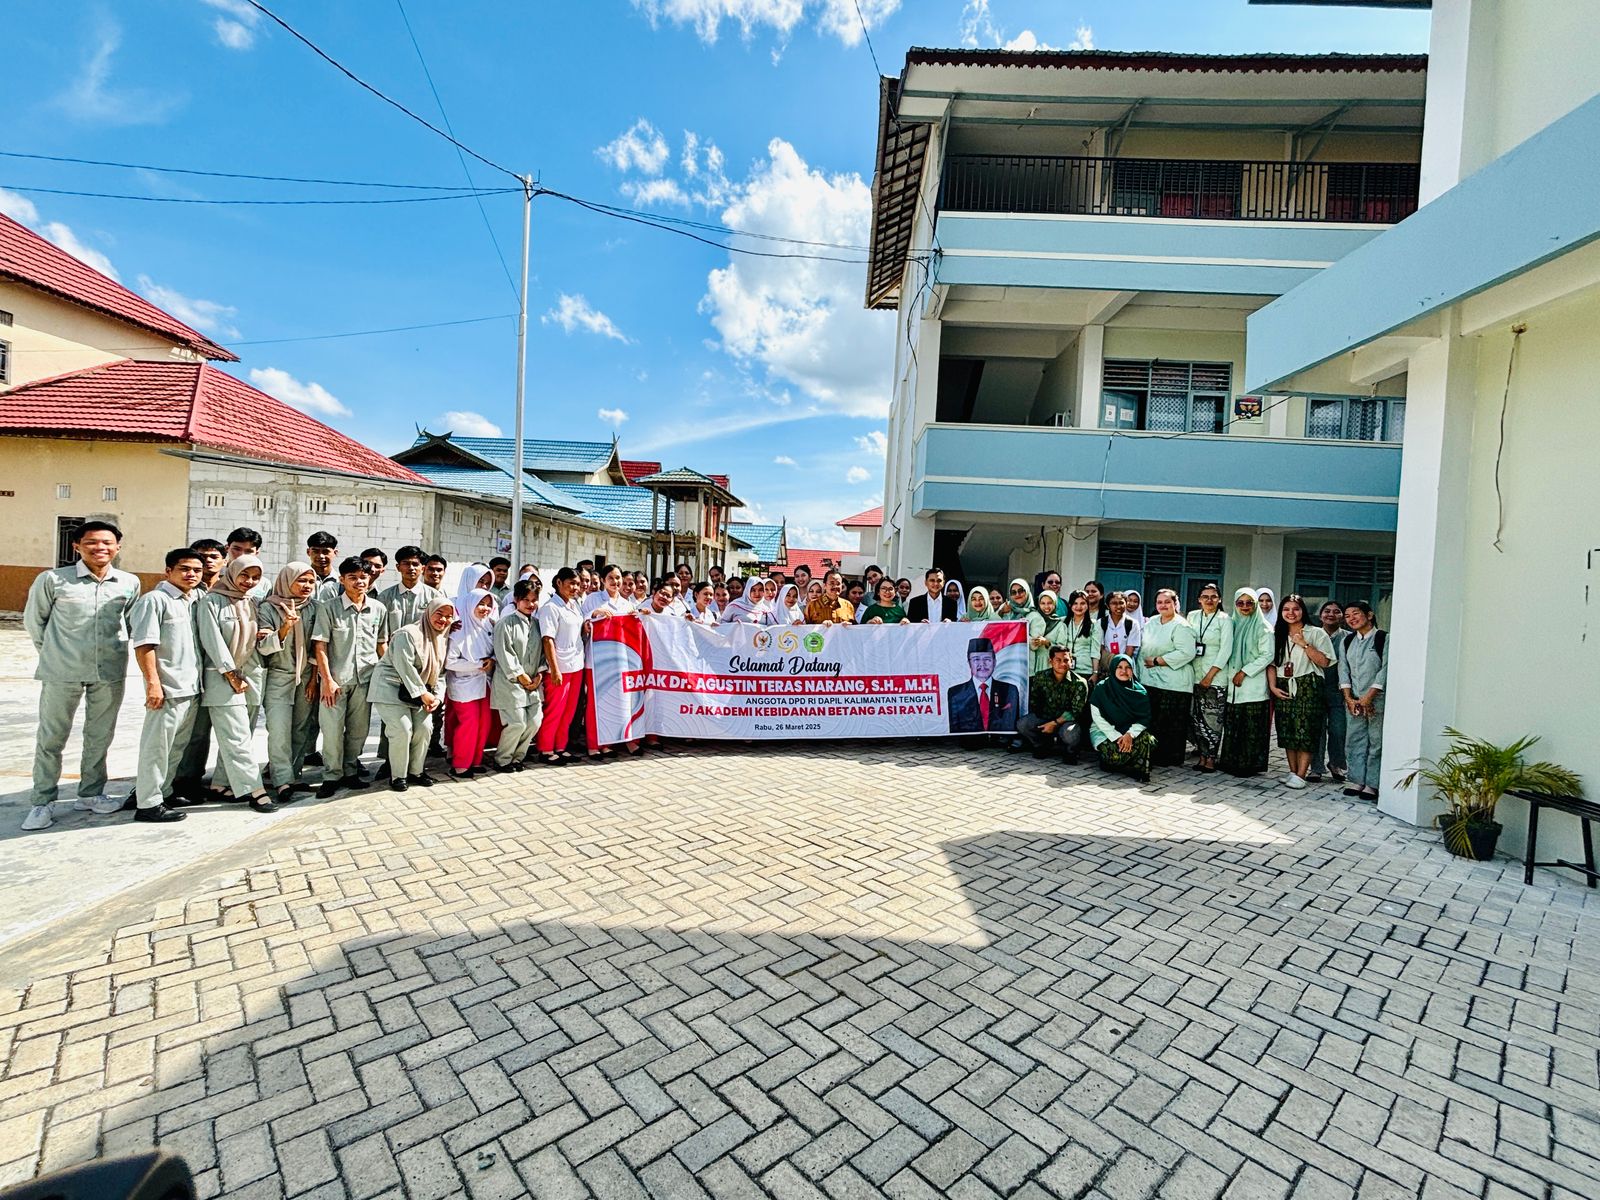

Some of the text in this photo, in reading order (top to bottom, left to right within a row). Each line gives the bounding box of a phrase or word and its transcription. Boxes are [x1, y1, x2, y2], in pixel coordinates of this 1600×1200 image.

[728, 655, 842, 678] Selamat Datang
[669, 675, 692, 689] Dr.
[695, 678, 757, 692] AGUSTIN
[759, 680, 803, 692] TERAS
[804, 680, 869, 693] NARANG,
[871, 679, 903, 693] S.H.,
[904, 678, 937, 691] M.H.
[745, 697, 787, 705] ANGGOTA
[788, 697, 806, 705] DPD
[807, 697, 816, 705] RI
[818, 697, 842, 705] DAPIL
[844, 696, 897, 704] KALIMANTAN
[679, 704, 933, 716] Di AKADEMI KEBIDANAN BETANG ASI RAYA
